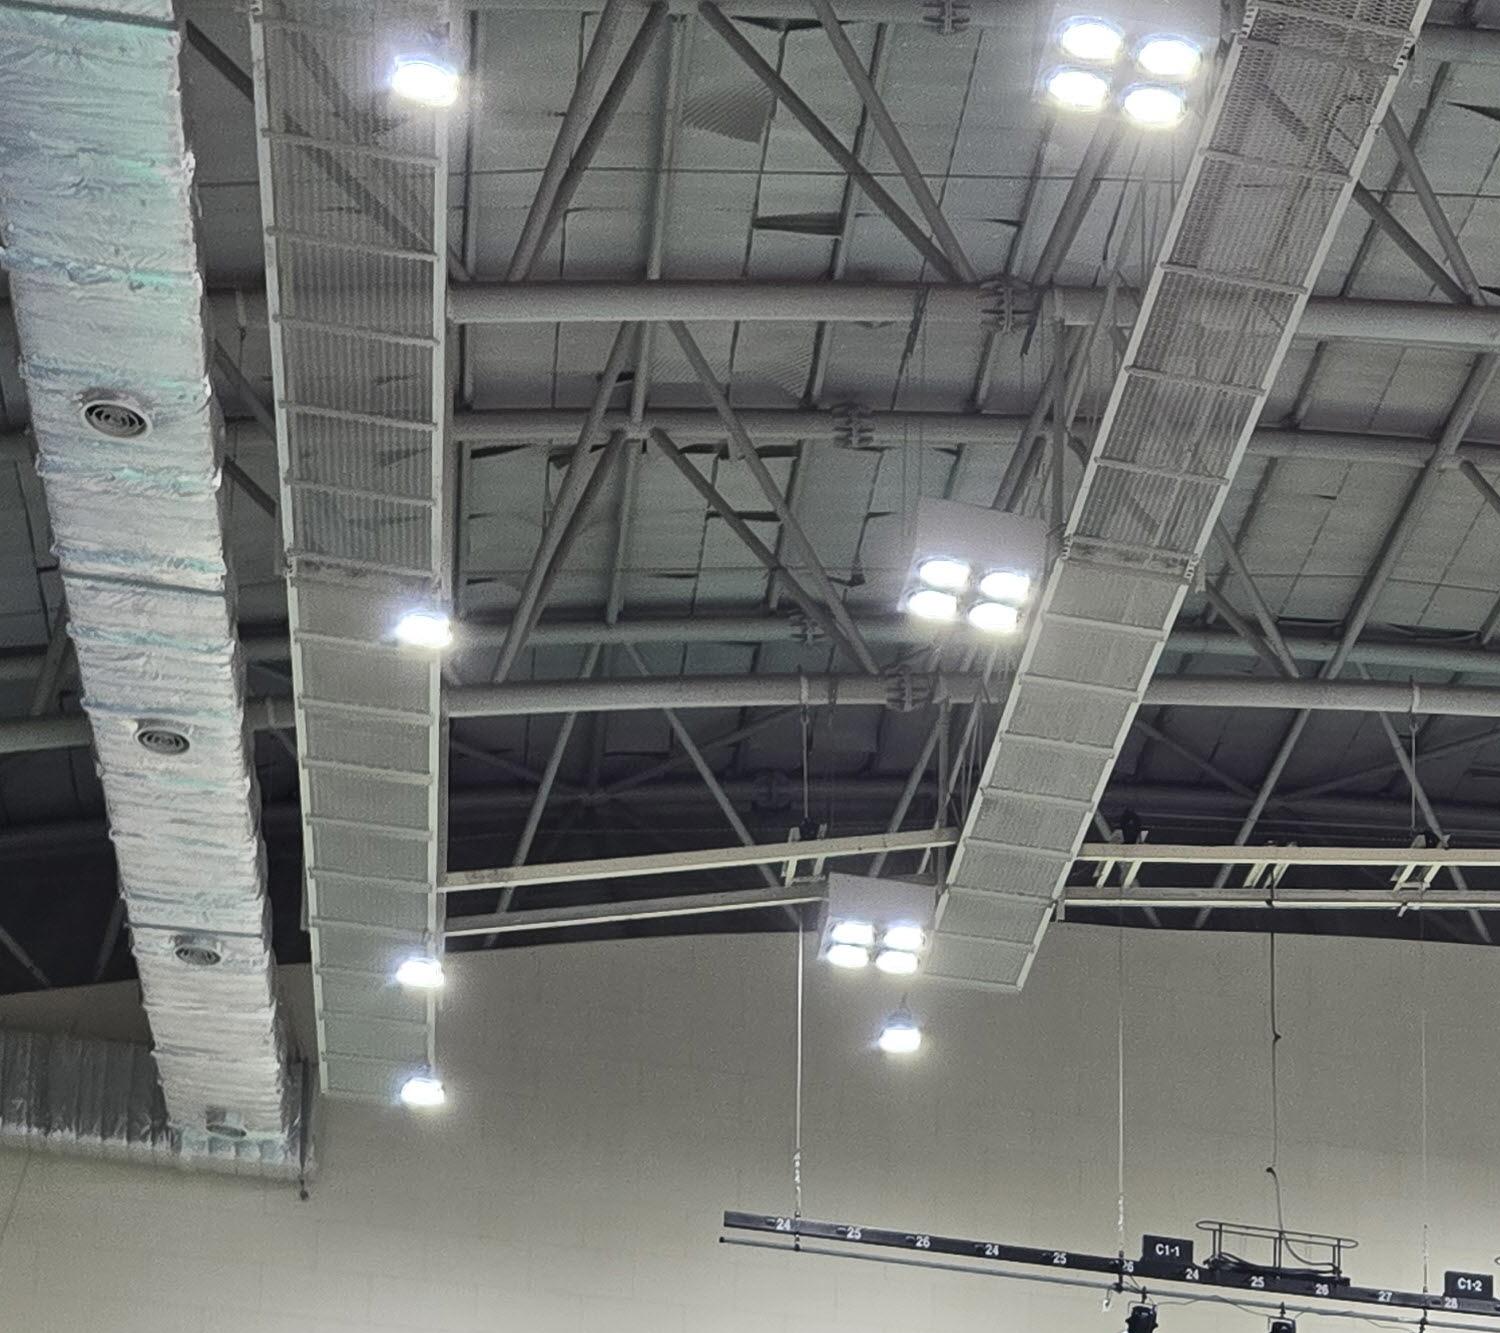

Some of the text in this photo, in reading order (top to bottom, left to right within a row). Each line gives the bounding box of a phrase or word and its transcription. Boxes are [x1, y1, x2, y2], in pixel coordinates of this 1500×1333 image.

[776, 1218, 791, 1231] 24
[846, 1227, 862, 1240] 25
[915, 1235, 930, 1249] 26
[984, 1243, 999, 1256] 24
[1155, 1243, 1180, 1257] C1-1
[1053, 1251, 1067, 1264] 25
[1185, 1268, 1199, 1281] 24
[1250, 1276, 1265, 1288] 25
[1457, 1276, 1483, 1292] C1-2
[1378, 1290, 1392, 1302] 27
